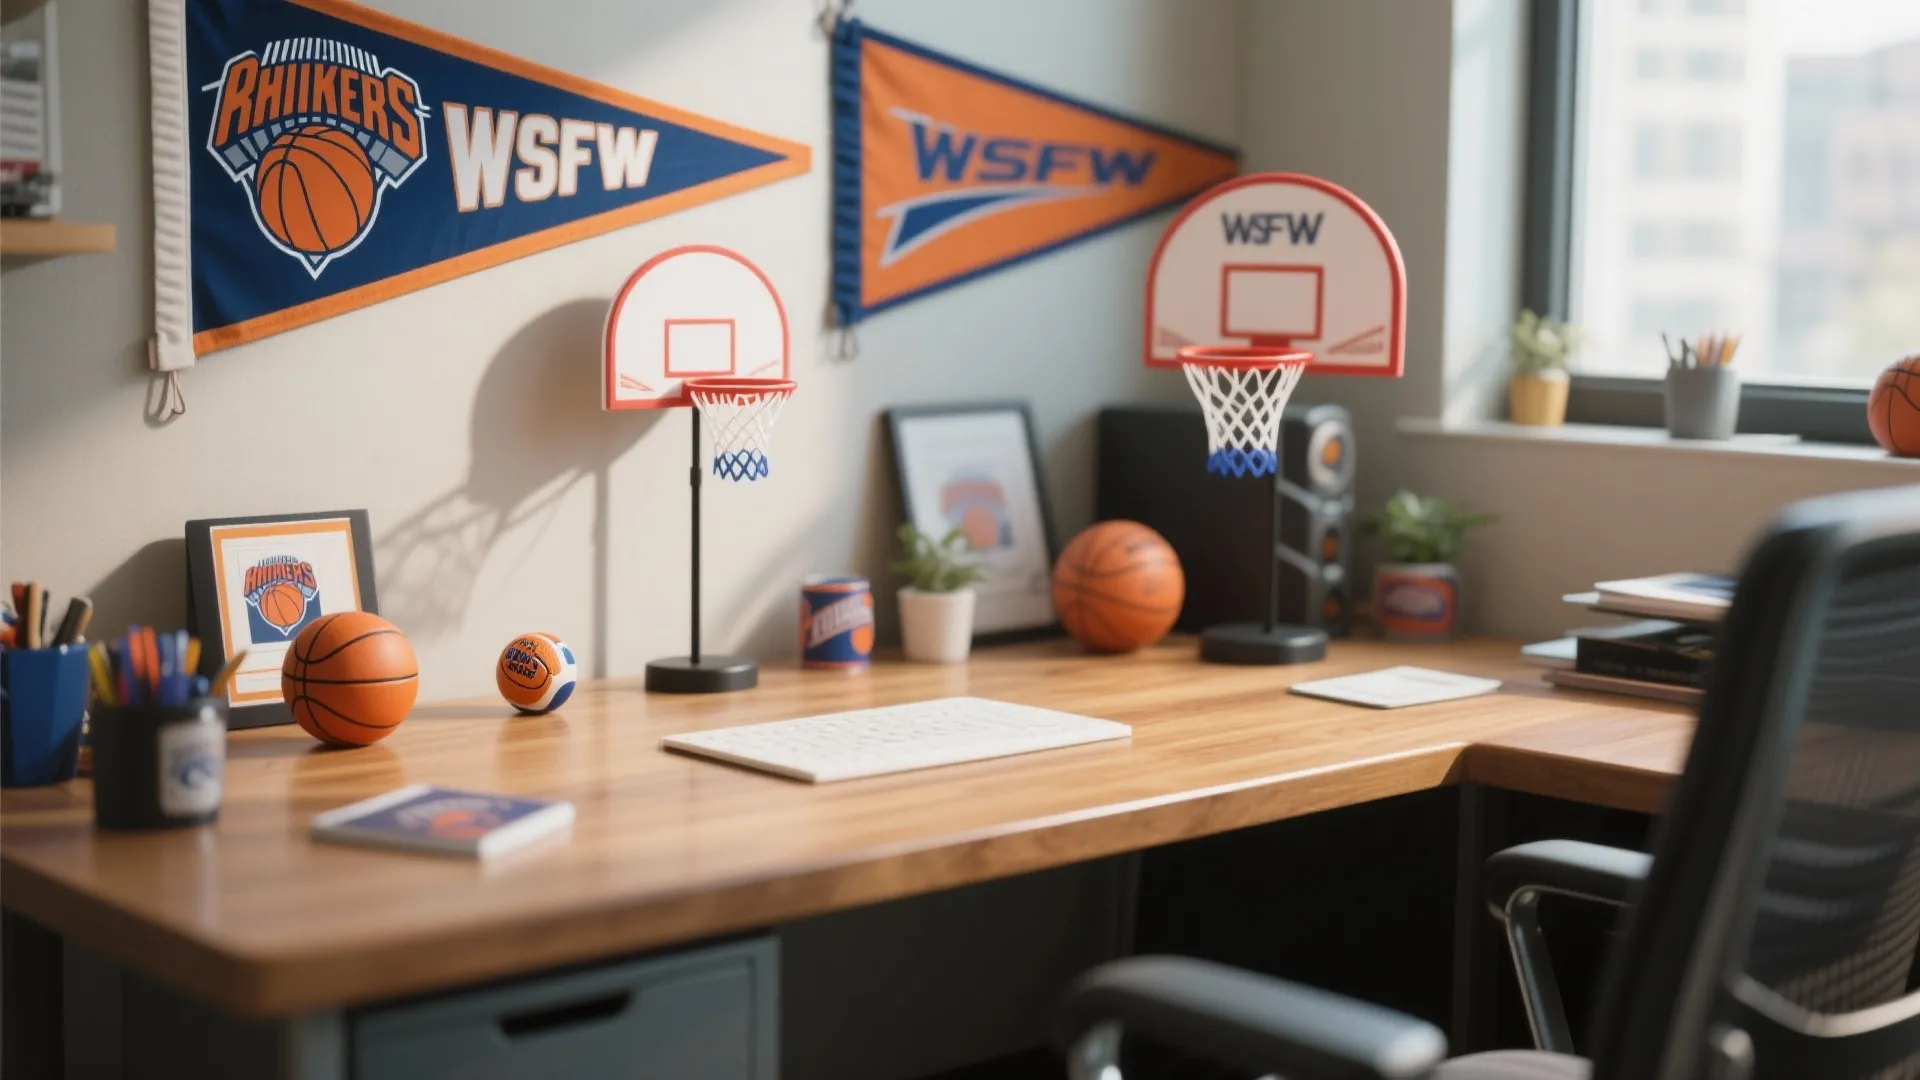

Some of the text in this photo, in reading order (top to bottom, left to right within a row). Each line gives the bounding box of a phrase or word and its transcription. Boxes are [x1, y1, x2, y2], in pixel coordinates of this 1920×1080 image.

[443, 102, 659, 212] WSFW
[911, 120, 1157, 185] WSFW
[1221, 211, 1324, 245] WSFW
